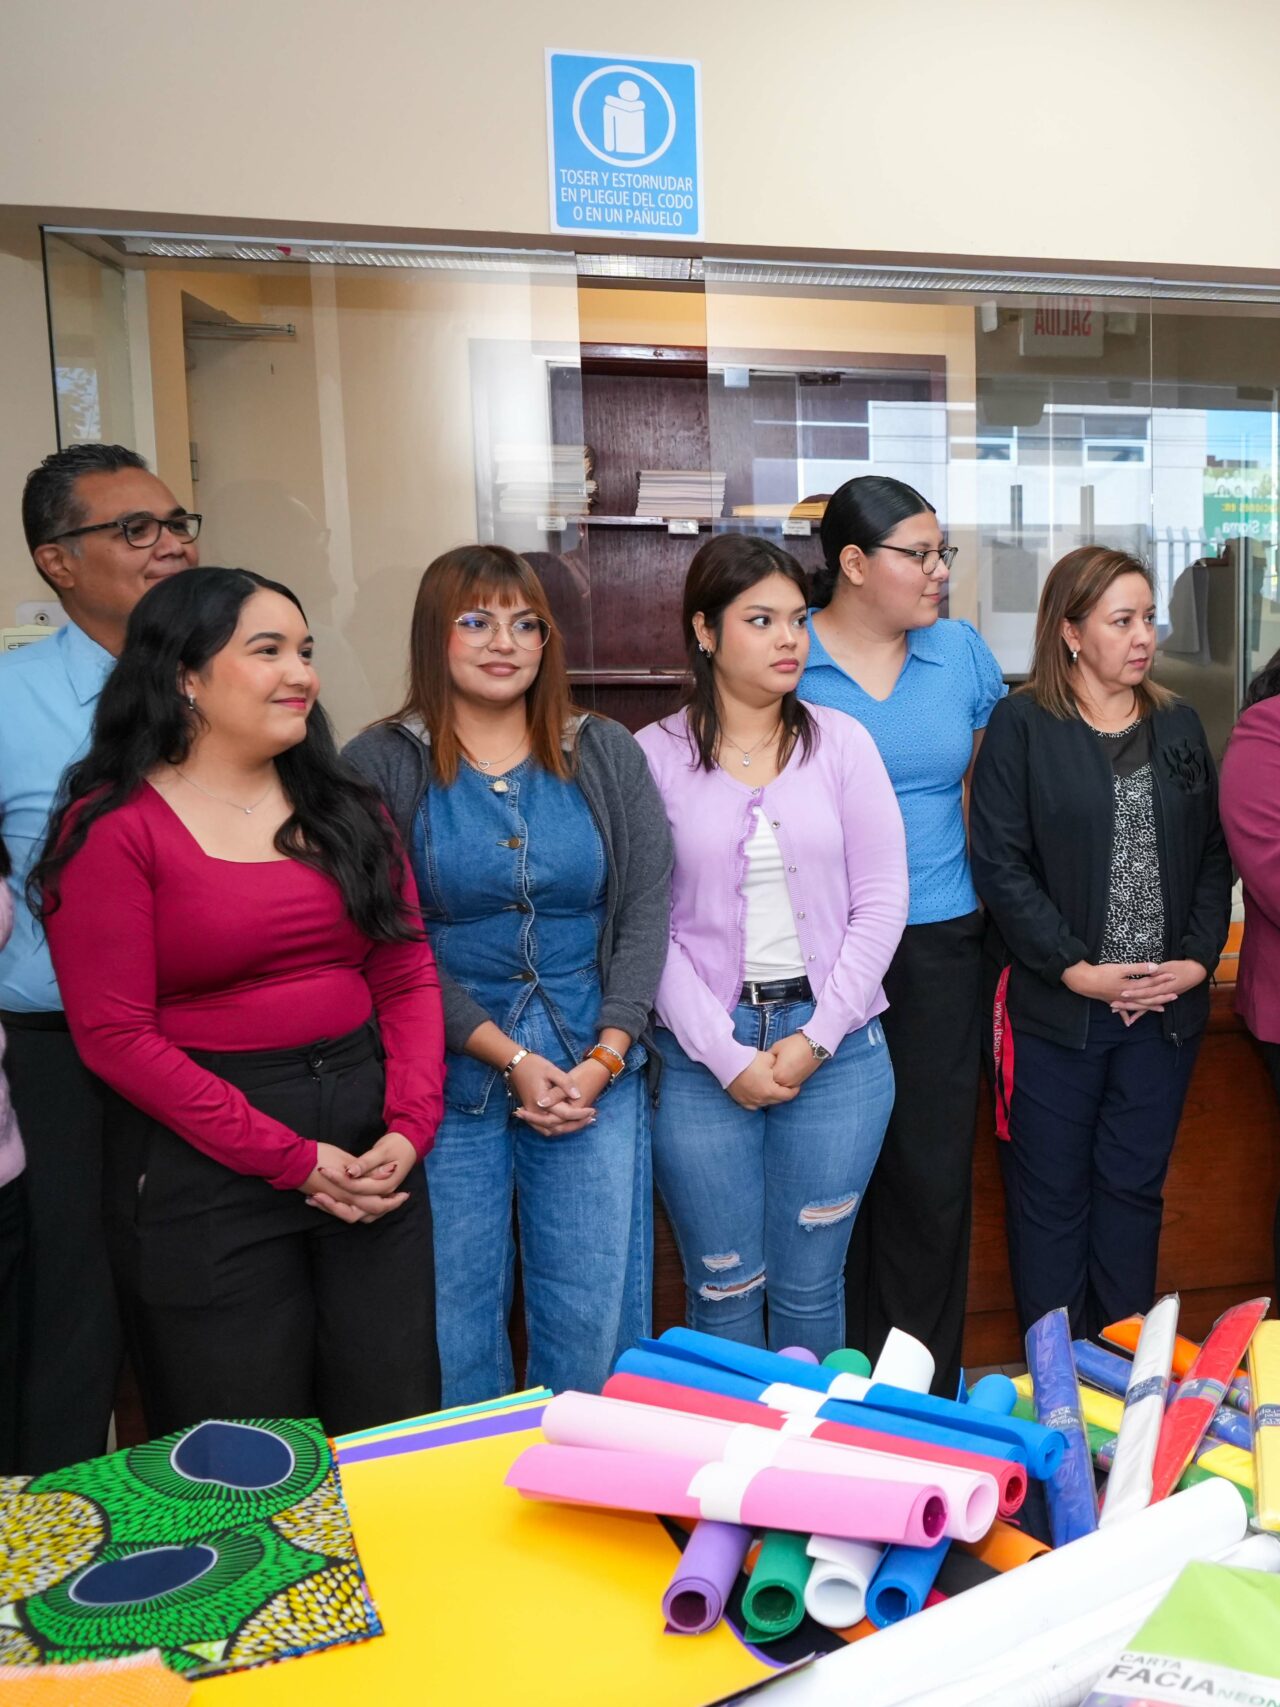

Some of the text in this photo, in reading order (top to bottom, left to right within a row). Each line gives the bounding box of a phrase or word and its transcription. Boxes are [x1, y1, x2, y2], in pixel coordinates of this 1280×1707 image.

[560, 169, 693, 192] TOSER Y ESTORNUDAR
[561, 188, 694, 210] EN PLIEGUE DEL CODO
[573, 206, 682, 226] O EN UN PAÑUELO
[1120, 1654, 1182, 1669] CARTA
[1106, 1664, 1215, 1696] FACIA
